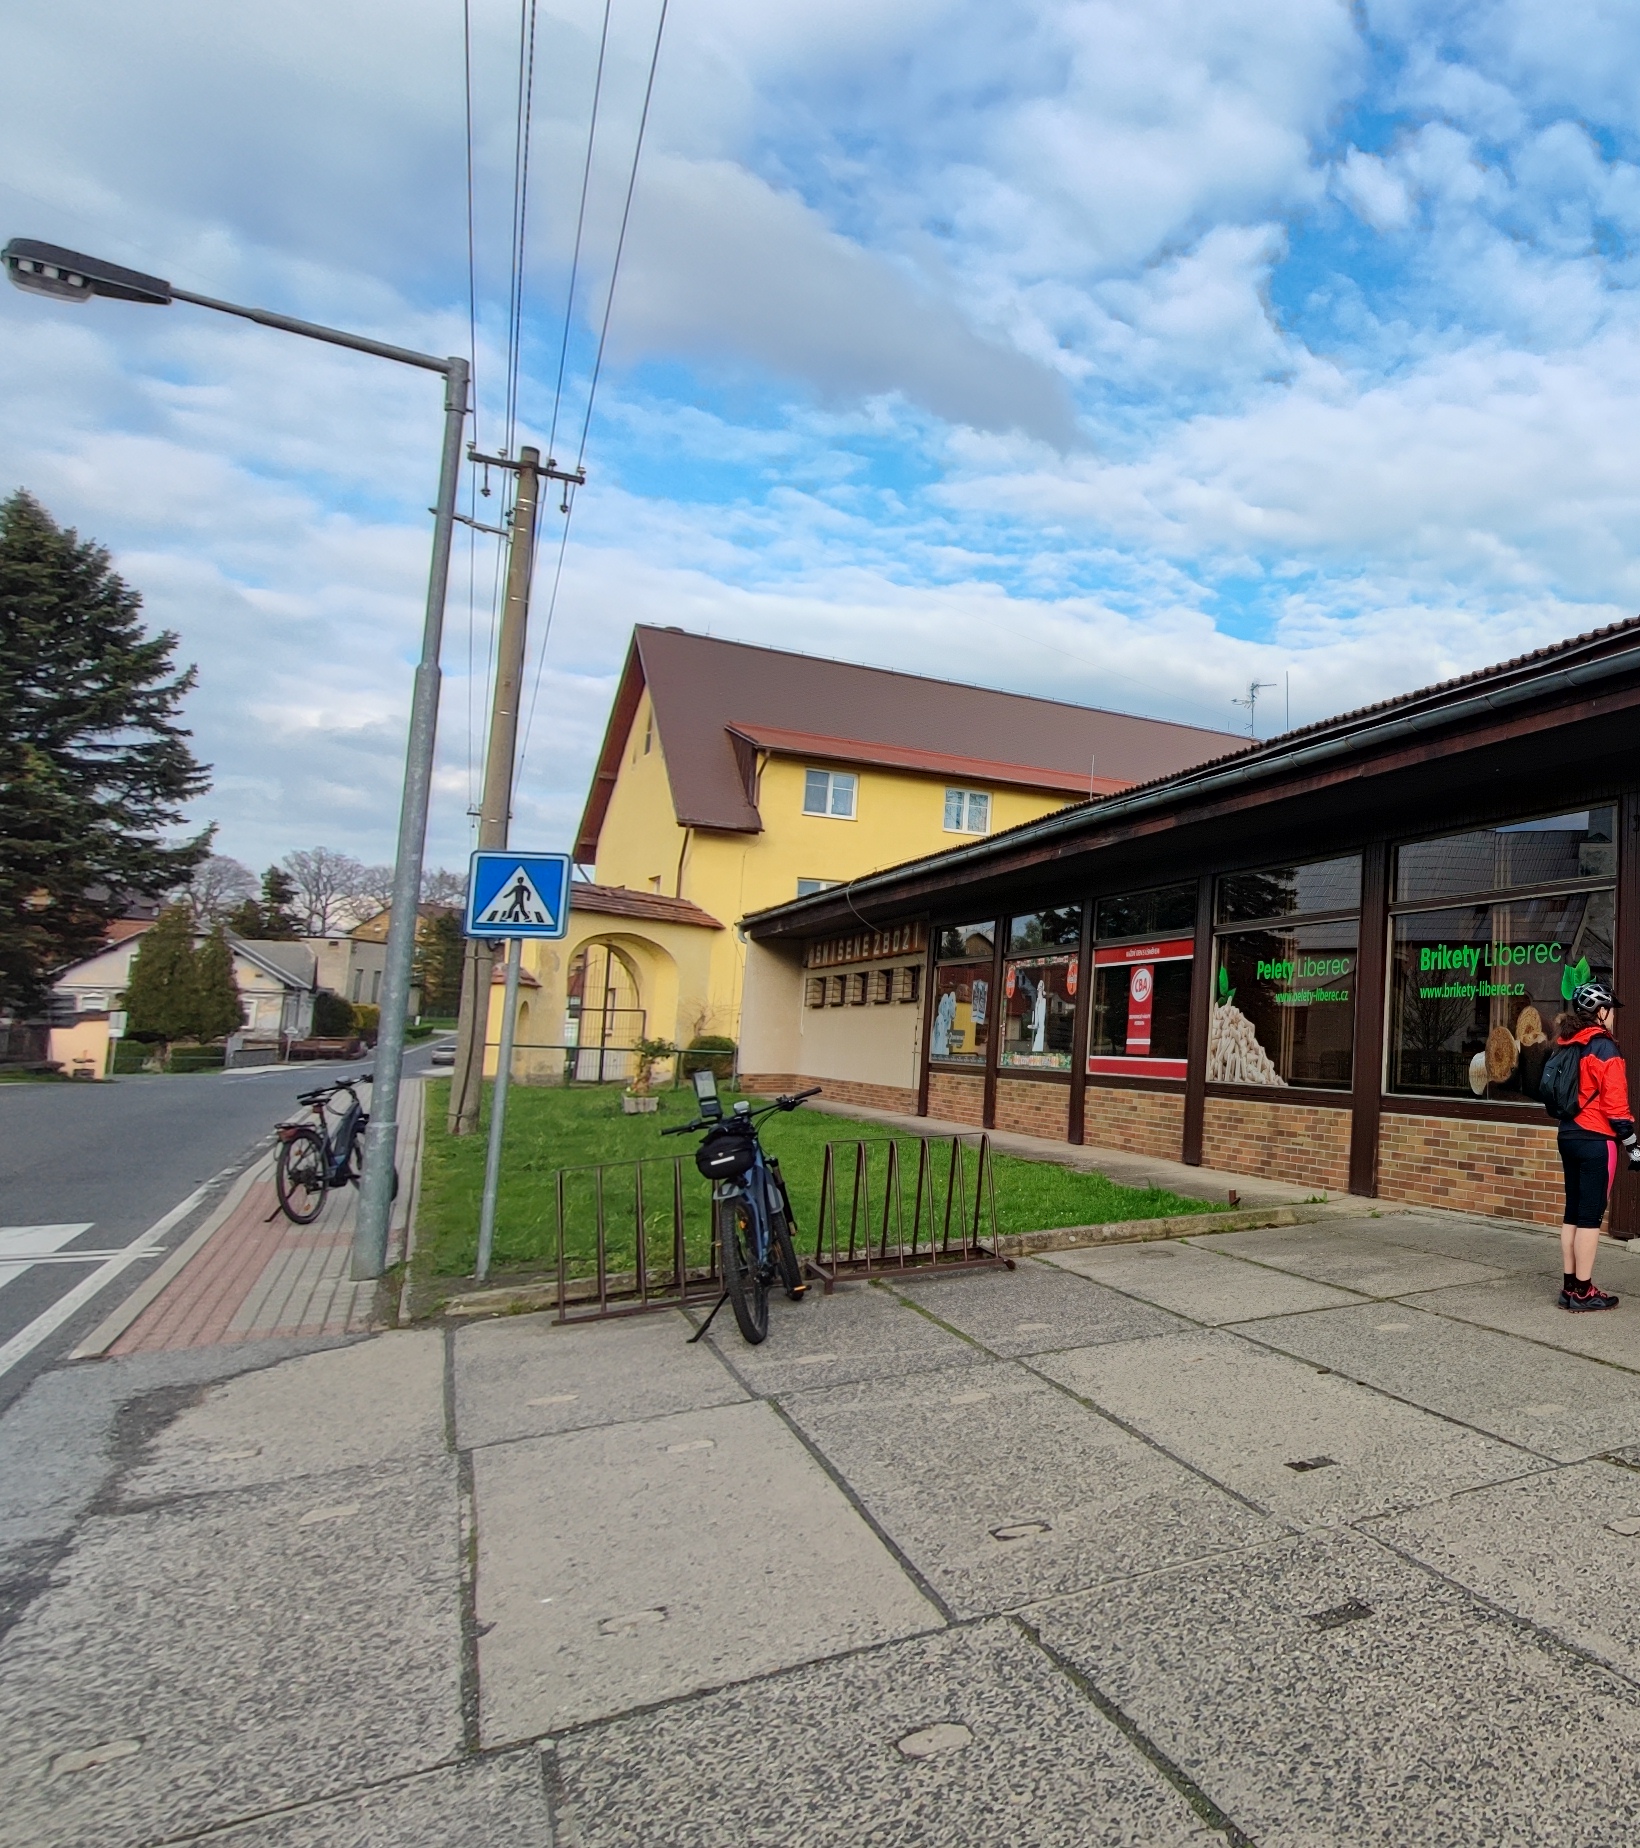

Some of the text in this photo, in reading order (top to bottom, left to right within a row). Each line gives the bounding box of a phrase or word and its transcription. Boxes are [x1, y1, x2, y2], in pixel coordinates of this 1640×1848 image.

[1420, 940, 1562, 976] Brikety Liberec
[1257, 956, 1350, 986] Pelety Liberec
[1135, 977, 1148, 993] CBA
[1420, 980, 1525, 1001] www.brikety-liberec.cz
[1275, 988, 1349, 1005] www.pelety-liberec.cz
